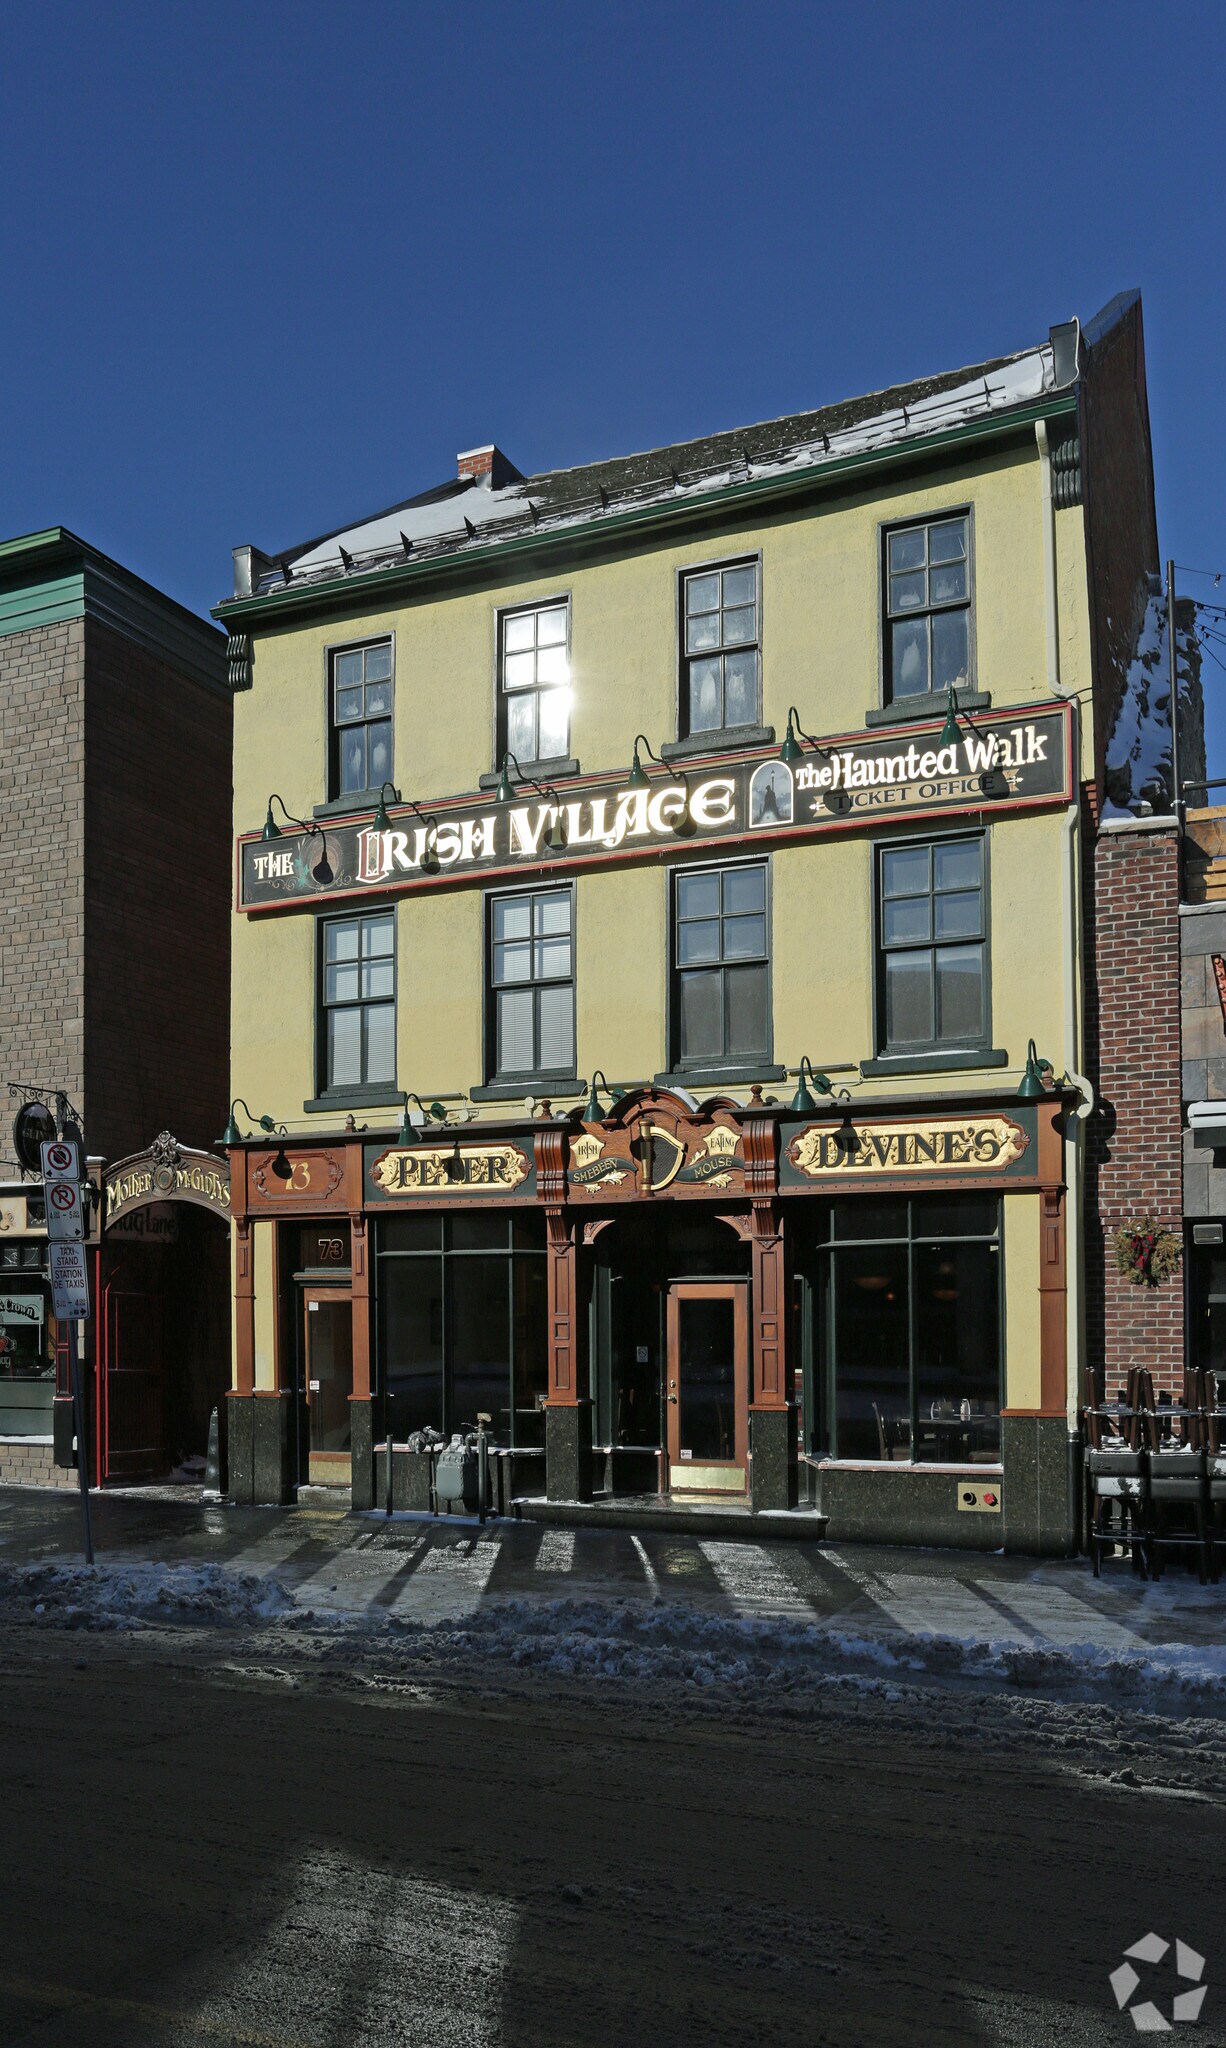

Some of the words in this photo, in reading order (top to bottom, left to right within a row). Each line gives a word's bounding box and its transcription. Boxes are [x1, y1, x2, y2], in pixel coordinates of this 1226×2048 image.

[830, 744, 959, 790] Haunted
[963, 726, 1048, 772] Walk
[834, 786, 911, 810] TICKET
[918, 775, 995, 799] OFFICE
[253, 851, 295, 880] THE
[355, 816, 498, 884] IRISH
[508, 779, 736, 855] VILLAGE
[578, 1142, 598, 1159] IRISH
[815, 1127, 1000, 1169] DEVINE'S
[397, 1155, 511, 1188] PETER
[106, 1172, 152, 1217] MOTHER
[60, 1246, 75, 1256] TAXI
[318, 1238, 344, 1260] 73
[56, 1256, 79, 1266] STAND
[53, 1280, 63, 1290] DE
[66, 1279, 85, 1289] TAXIS
[54, 1269, 82, 1280] STATION
[5, 1299, 35, 1317] Crown
